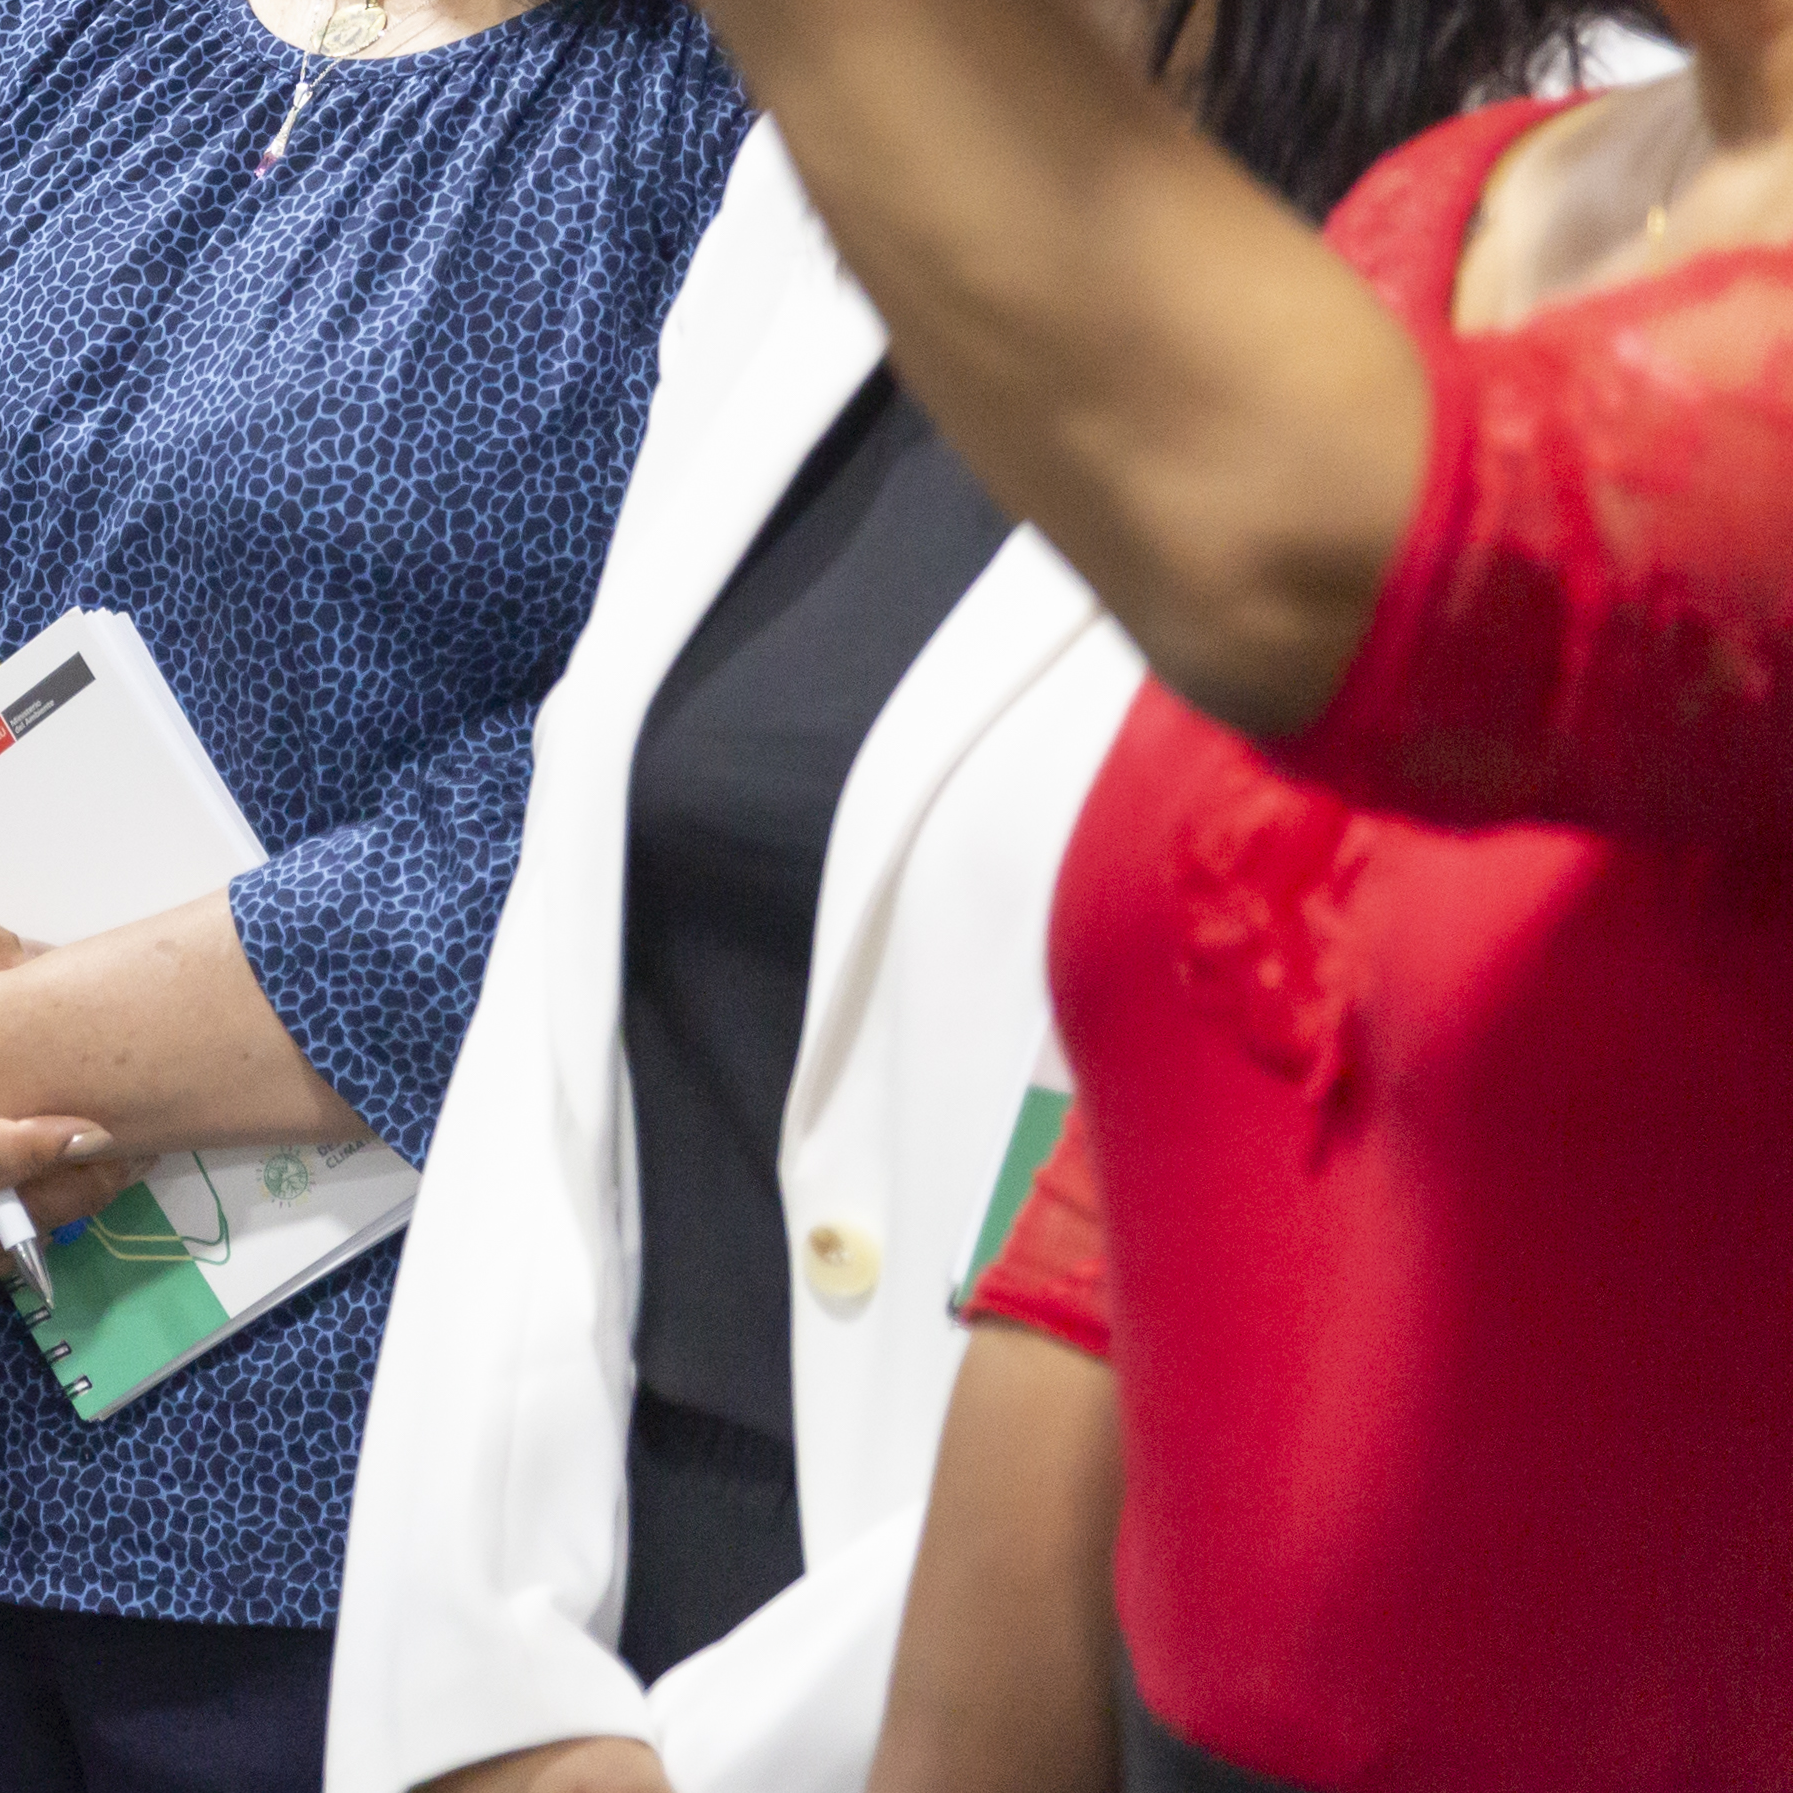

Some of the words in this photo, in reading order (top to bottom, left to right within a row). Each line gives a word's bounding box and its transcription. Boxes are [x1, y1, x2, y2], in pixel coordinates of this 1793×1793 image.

[10, 699, 42, 727] Ministerio
[15, 721, 26, 734] del
[25, 699, 55, 726] Ambiente
